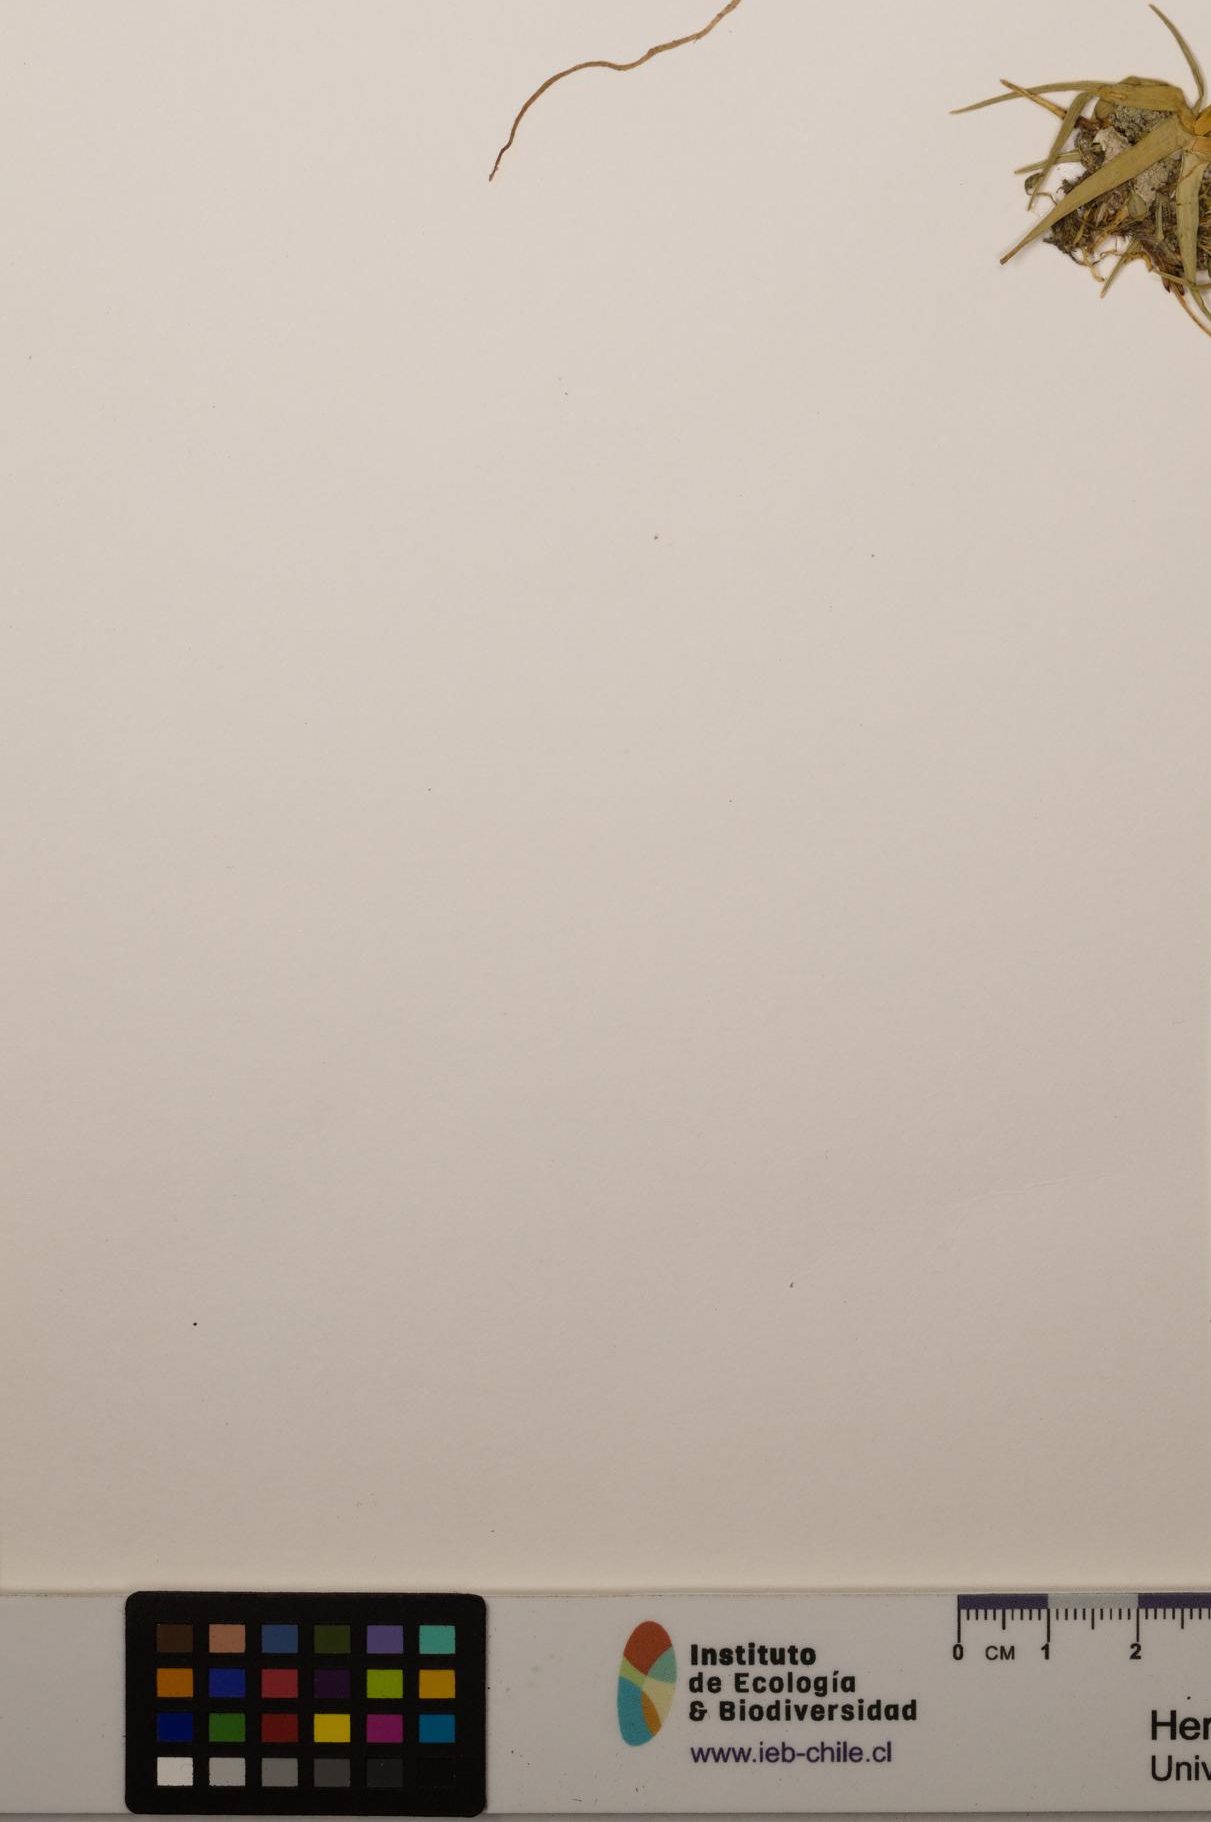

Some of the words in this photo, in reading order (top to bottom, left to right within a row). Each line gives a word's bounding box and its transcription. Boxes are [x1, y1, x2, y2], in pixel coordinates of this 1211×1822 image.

[690, 1641, 817, 1666] Instituto
[952, 1643, 964, 1661] 0
[984, 1645, 1016, 1661] CM
[1040, 1643, 1051, 1661] 1
[1129, 1643, 1142, 1661] 2
[688, 1671, 722, 1695] de
[734, 1670, 856, 1698] Ecología
[688, 1700, 708, 1722] &
[719, 1698, 917, 1722] Biodiversidad
[690, 1740, 892, 1764] www.ieb-chile.cl
